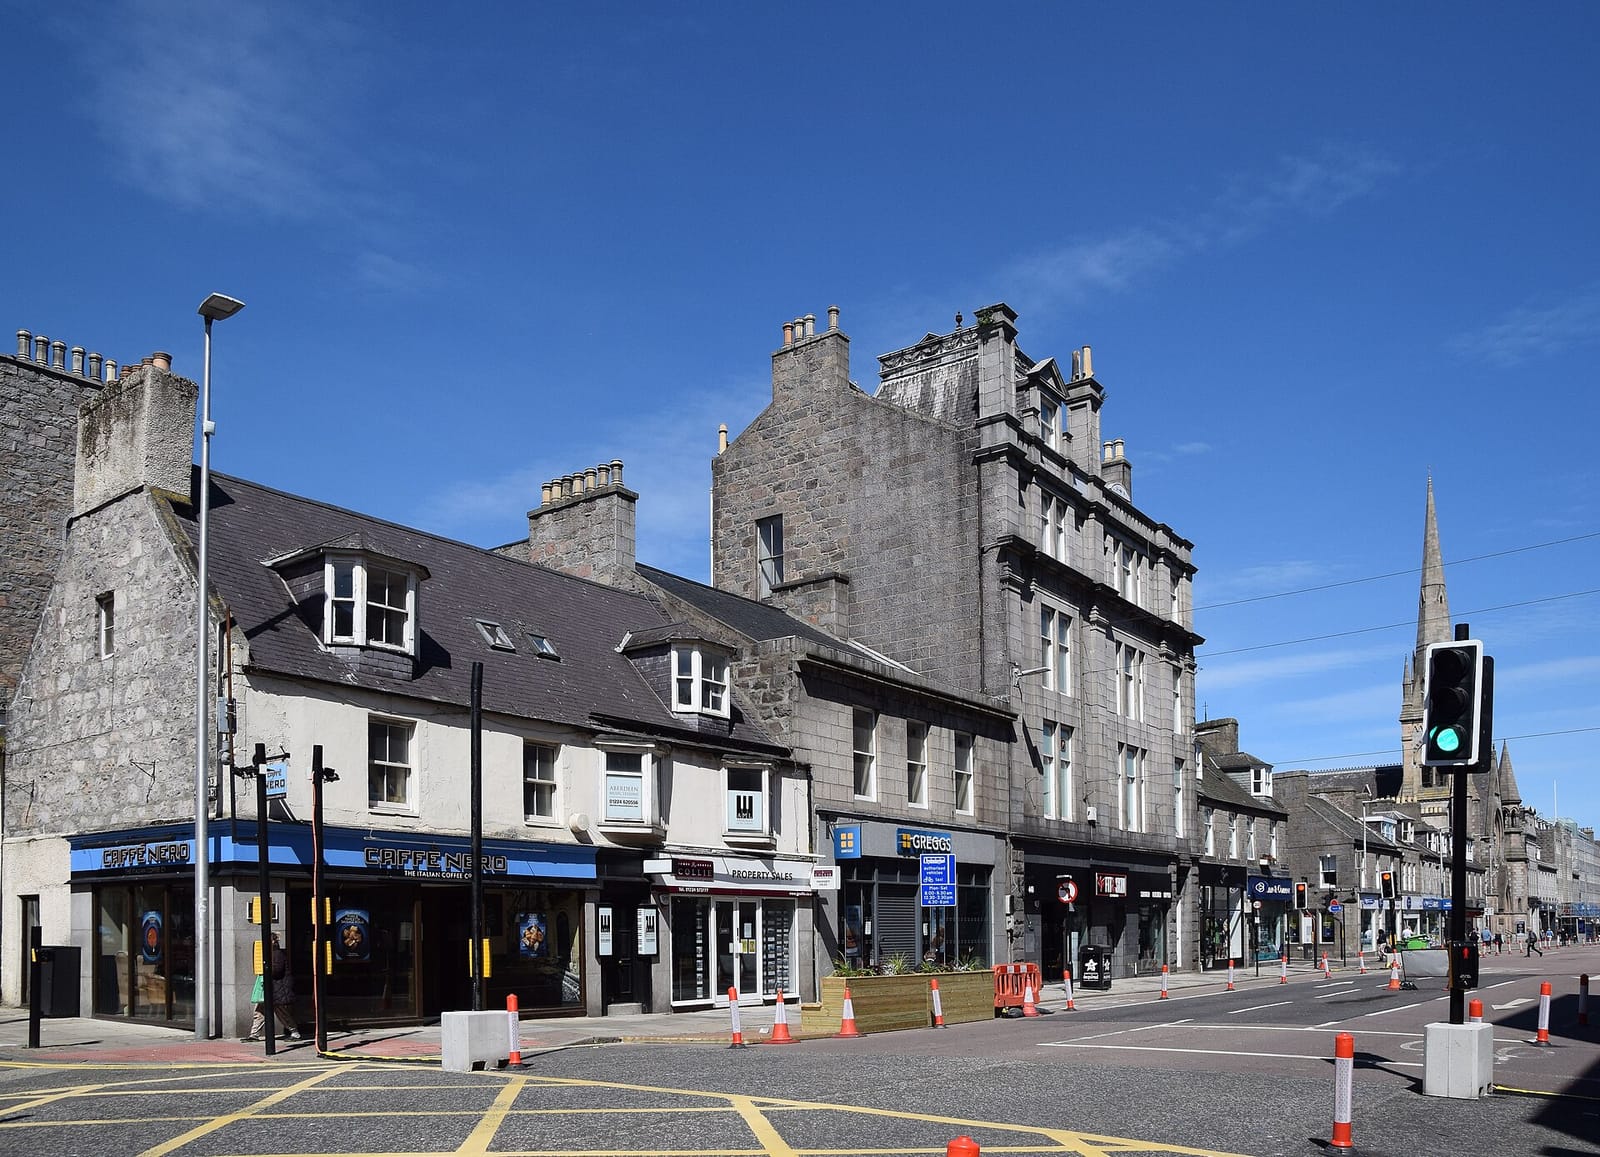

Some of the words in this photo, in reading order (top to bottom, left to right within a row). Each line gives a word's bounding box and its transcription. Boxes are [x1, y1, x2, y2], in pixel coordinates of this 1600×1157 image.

[912, 834, 951, 851] GREGGS
[147, 842, 190, 865] NERO
[445, 852, 508, 872] NERO
[416, 870, 441, 878] ITALIAN
[678, 868, 712, 877] COLLIE
[732, 869, 770, 880] PROPERTY
[771, 871, 793, 881] SALES
